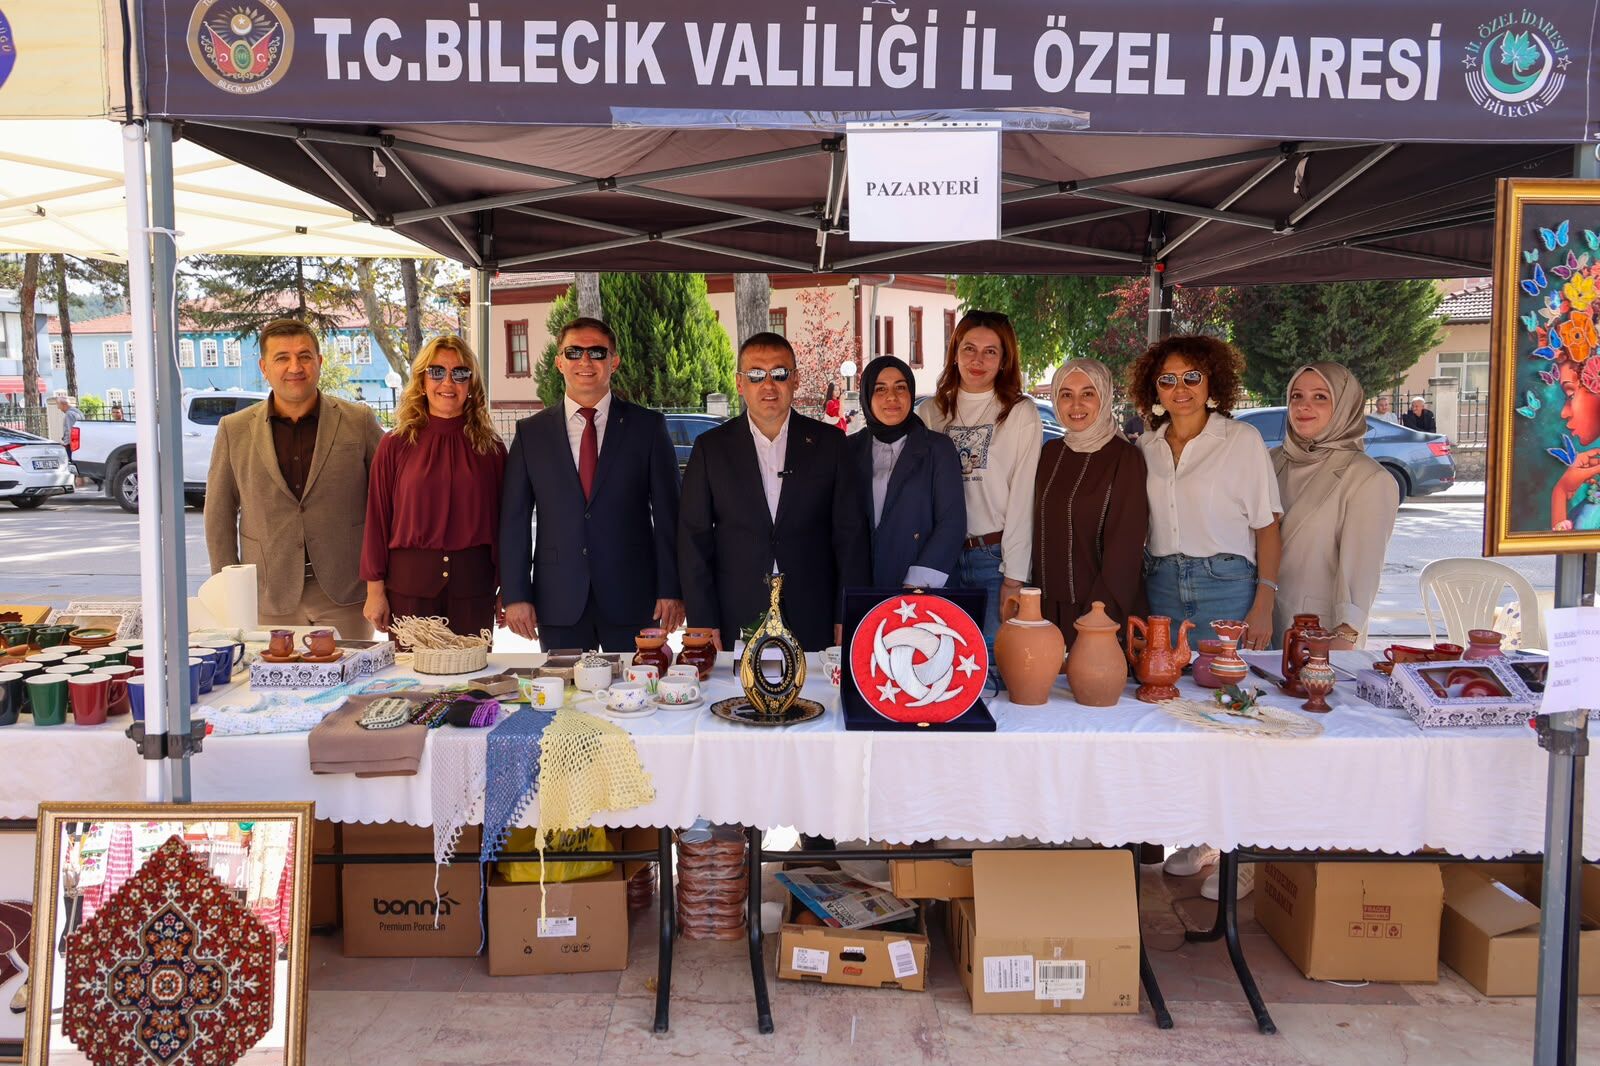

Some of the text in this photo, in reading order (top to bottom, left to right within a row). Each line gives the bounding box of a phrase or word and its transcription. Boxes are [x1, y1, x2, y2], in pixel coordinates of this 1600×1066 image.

[1478, 12, 1518, 39] ÖZEL
[1520, 8, 1569, 54] İDARESİ
[314, 3, 1442, 101] T.C.BİLECİK VALİLİĞİ İL ÖZEL İDARESİ
[1483, 98, 1544, 118] BİLECİK
[866, 176, 980, 197] PAZARYERİ
[379, 922, 412, 932] Premium
